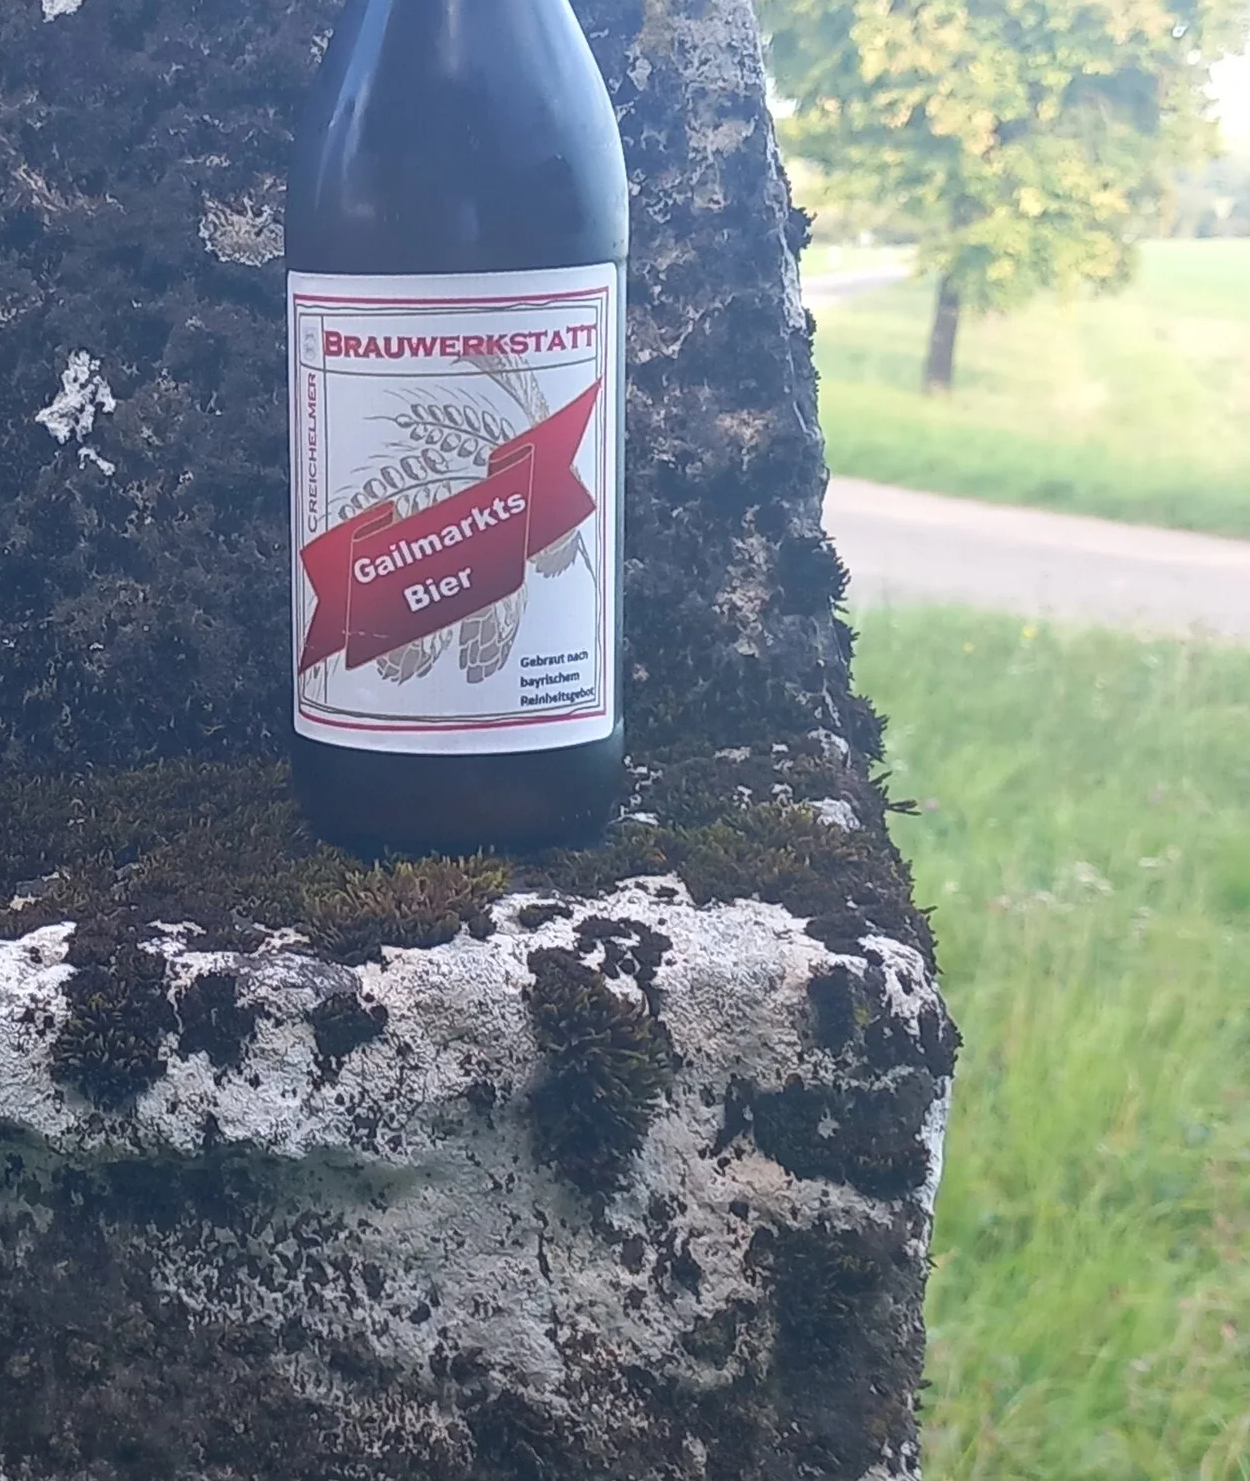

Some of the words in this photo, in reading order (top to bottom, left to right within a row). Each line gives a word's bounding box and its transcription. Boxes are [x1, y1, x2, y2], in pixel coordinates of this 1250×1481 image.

[323, 323, 597, 359] BRAUWERKSTATT
[307, 371, 317, 534] CREICHELMER
[353, 489, 527, 585] Gailmarkts
[403, 564, 474, 614] Bier
[520, 654, 565, 669] Gebraut
[567, 650, 589, 663] nach
[520, 672, 580, 689] bayrischem
